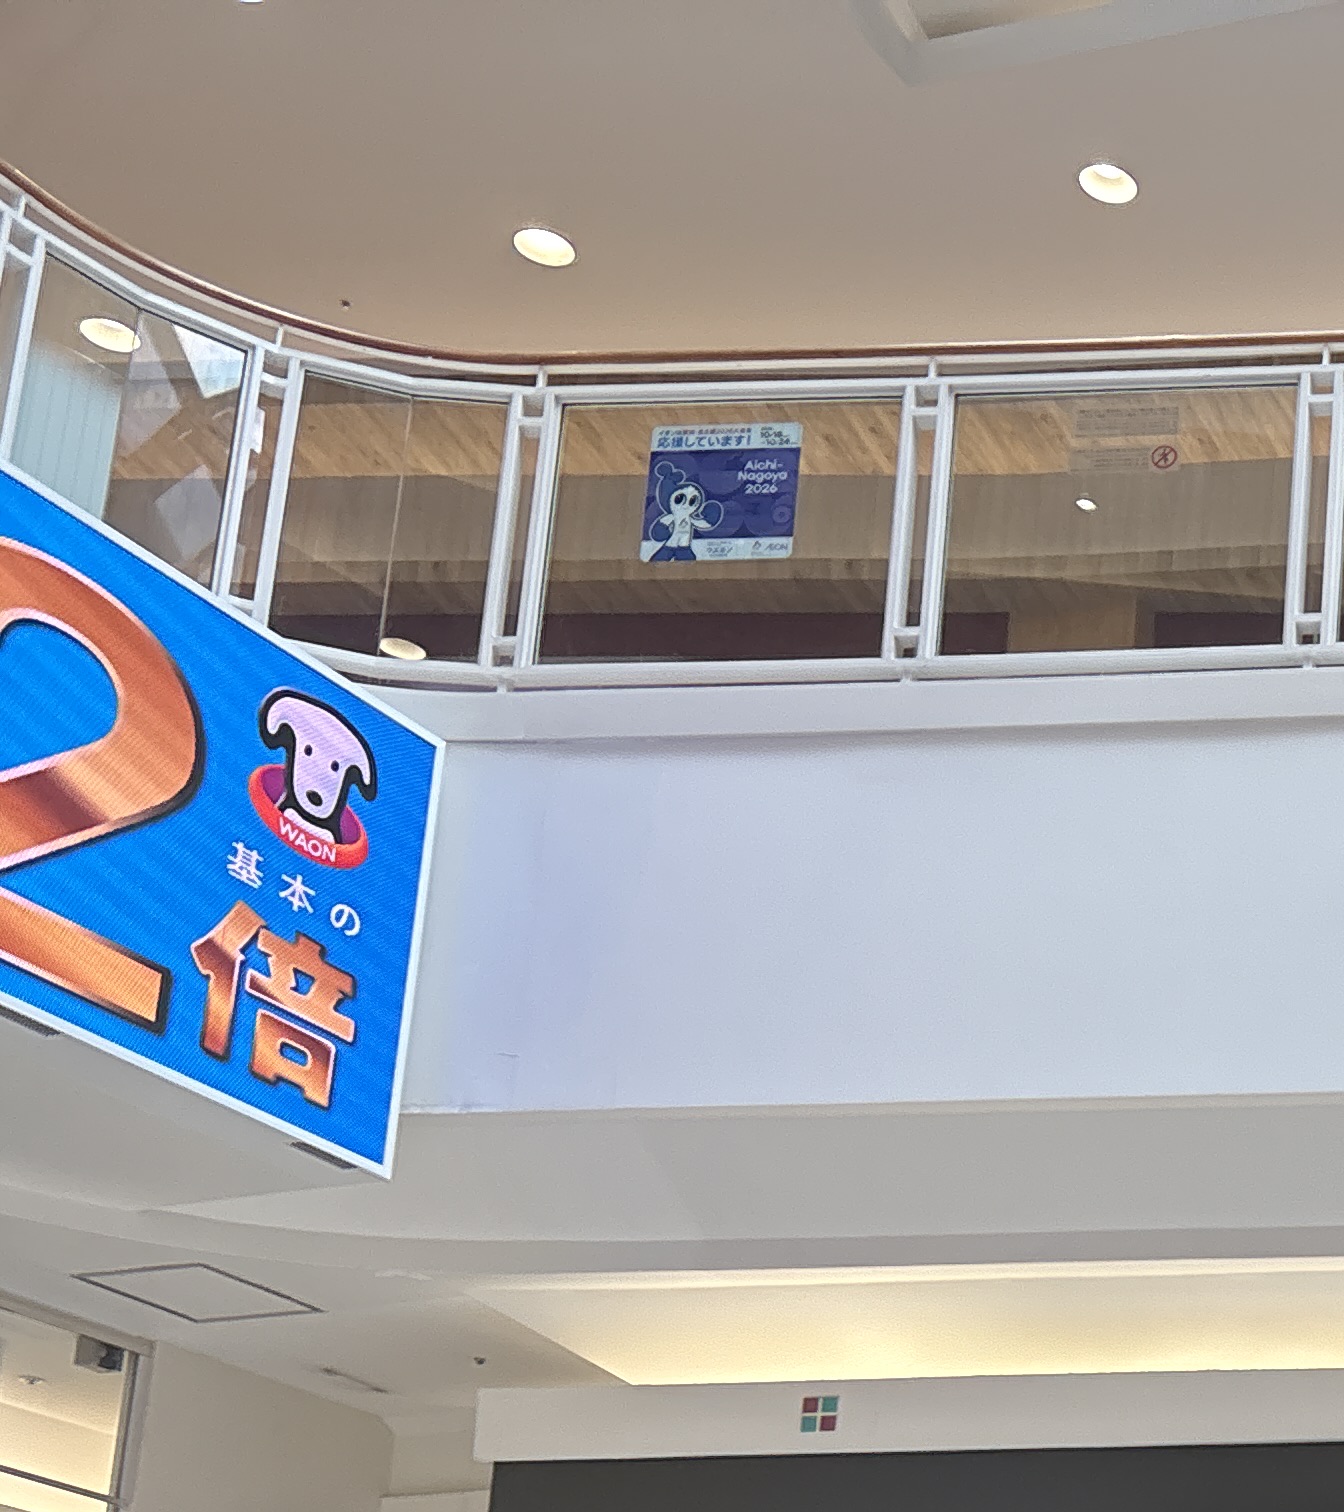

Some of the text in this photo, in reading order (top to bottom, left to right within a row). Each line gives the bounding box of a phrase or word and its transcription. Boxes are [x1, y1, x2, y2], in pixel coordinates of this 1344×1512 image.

[737, 471, 788, 484] Nagoya
[743, 459, 784, 471] Aichi-
[744, 483, 779, 494] 2026
[277, 816, 338, 864] WAON
[226, 840, 361, 937] 基本の
[190, 900, 358, 1111] 倍
